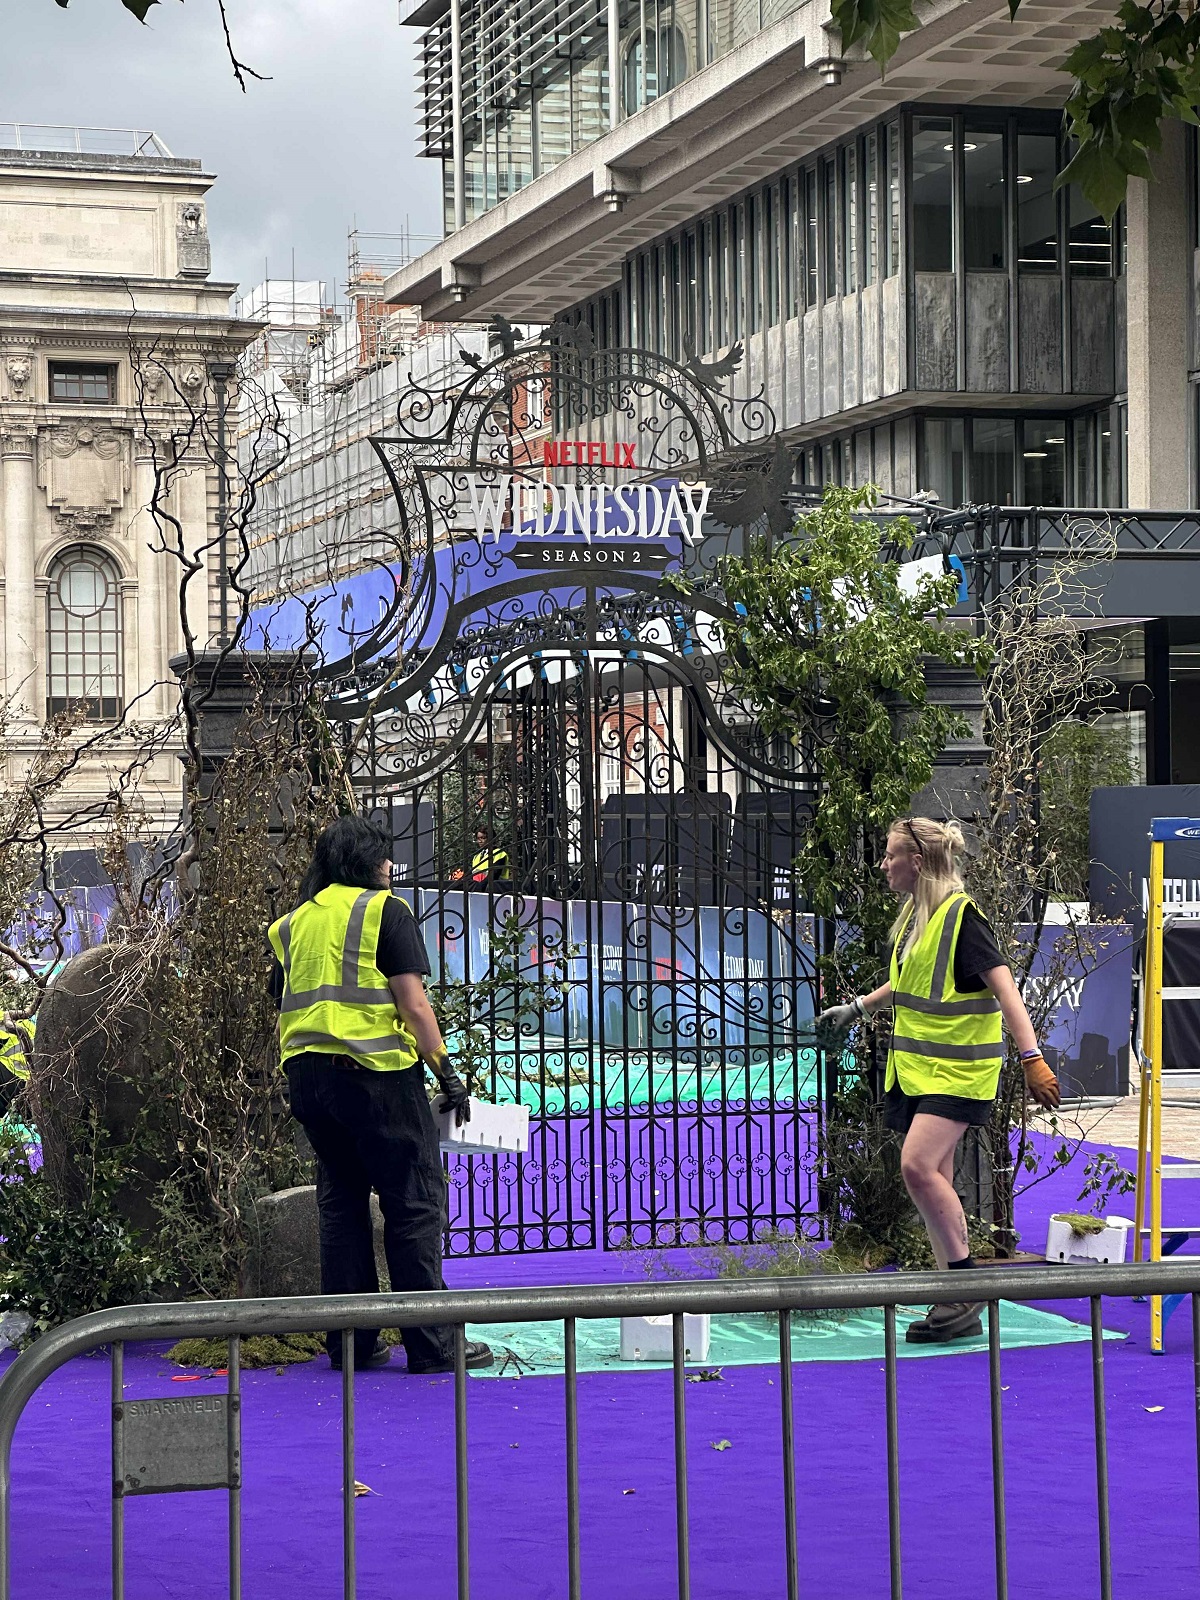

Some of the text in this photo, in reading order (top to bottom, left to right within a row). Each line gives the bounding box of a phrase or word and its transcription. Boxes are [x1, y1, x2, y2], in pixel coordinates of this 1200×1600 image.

[544, 441, 637, 468] NETFLIX
[467, 473, 713, 547] WEDNESDAY
[542, 549, 642, 563] SEASON 2
[129, 1399, 223, 1417] SMARTWELD
